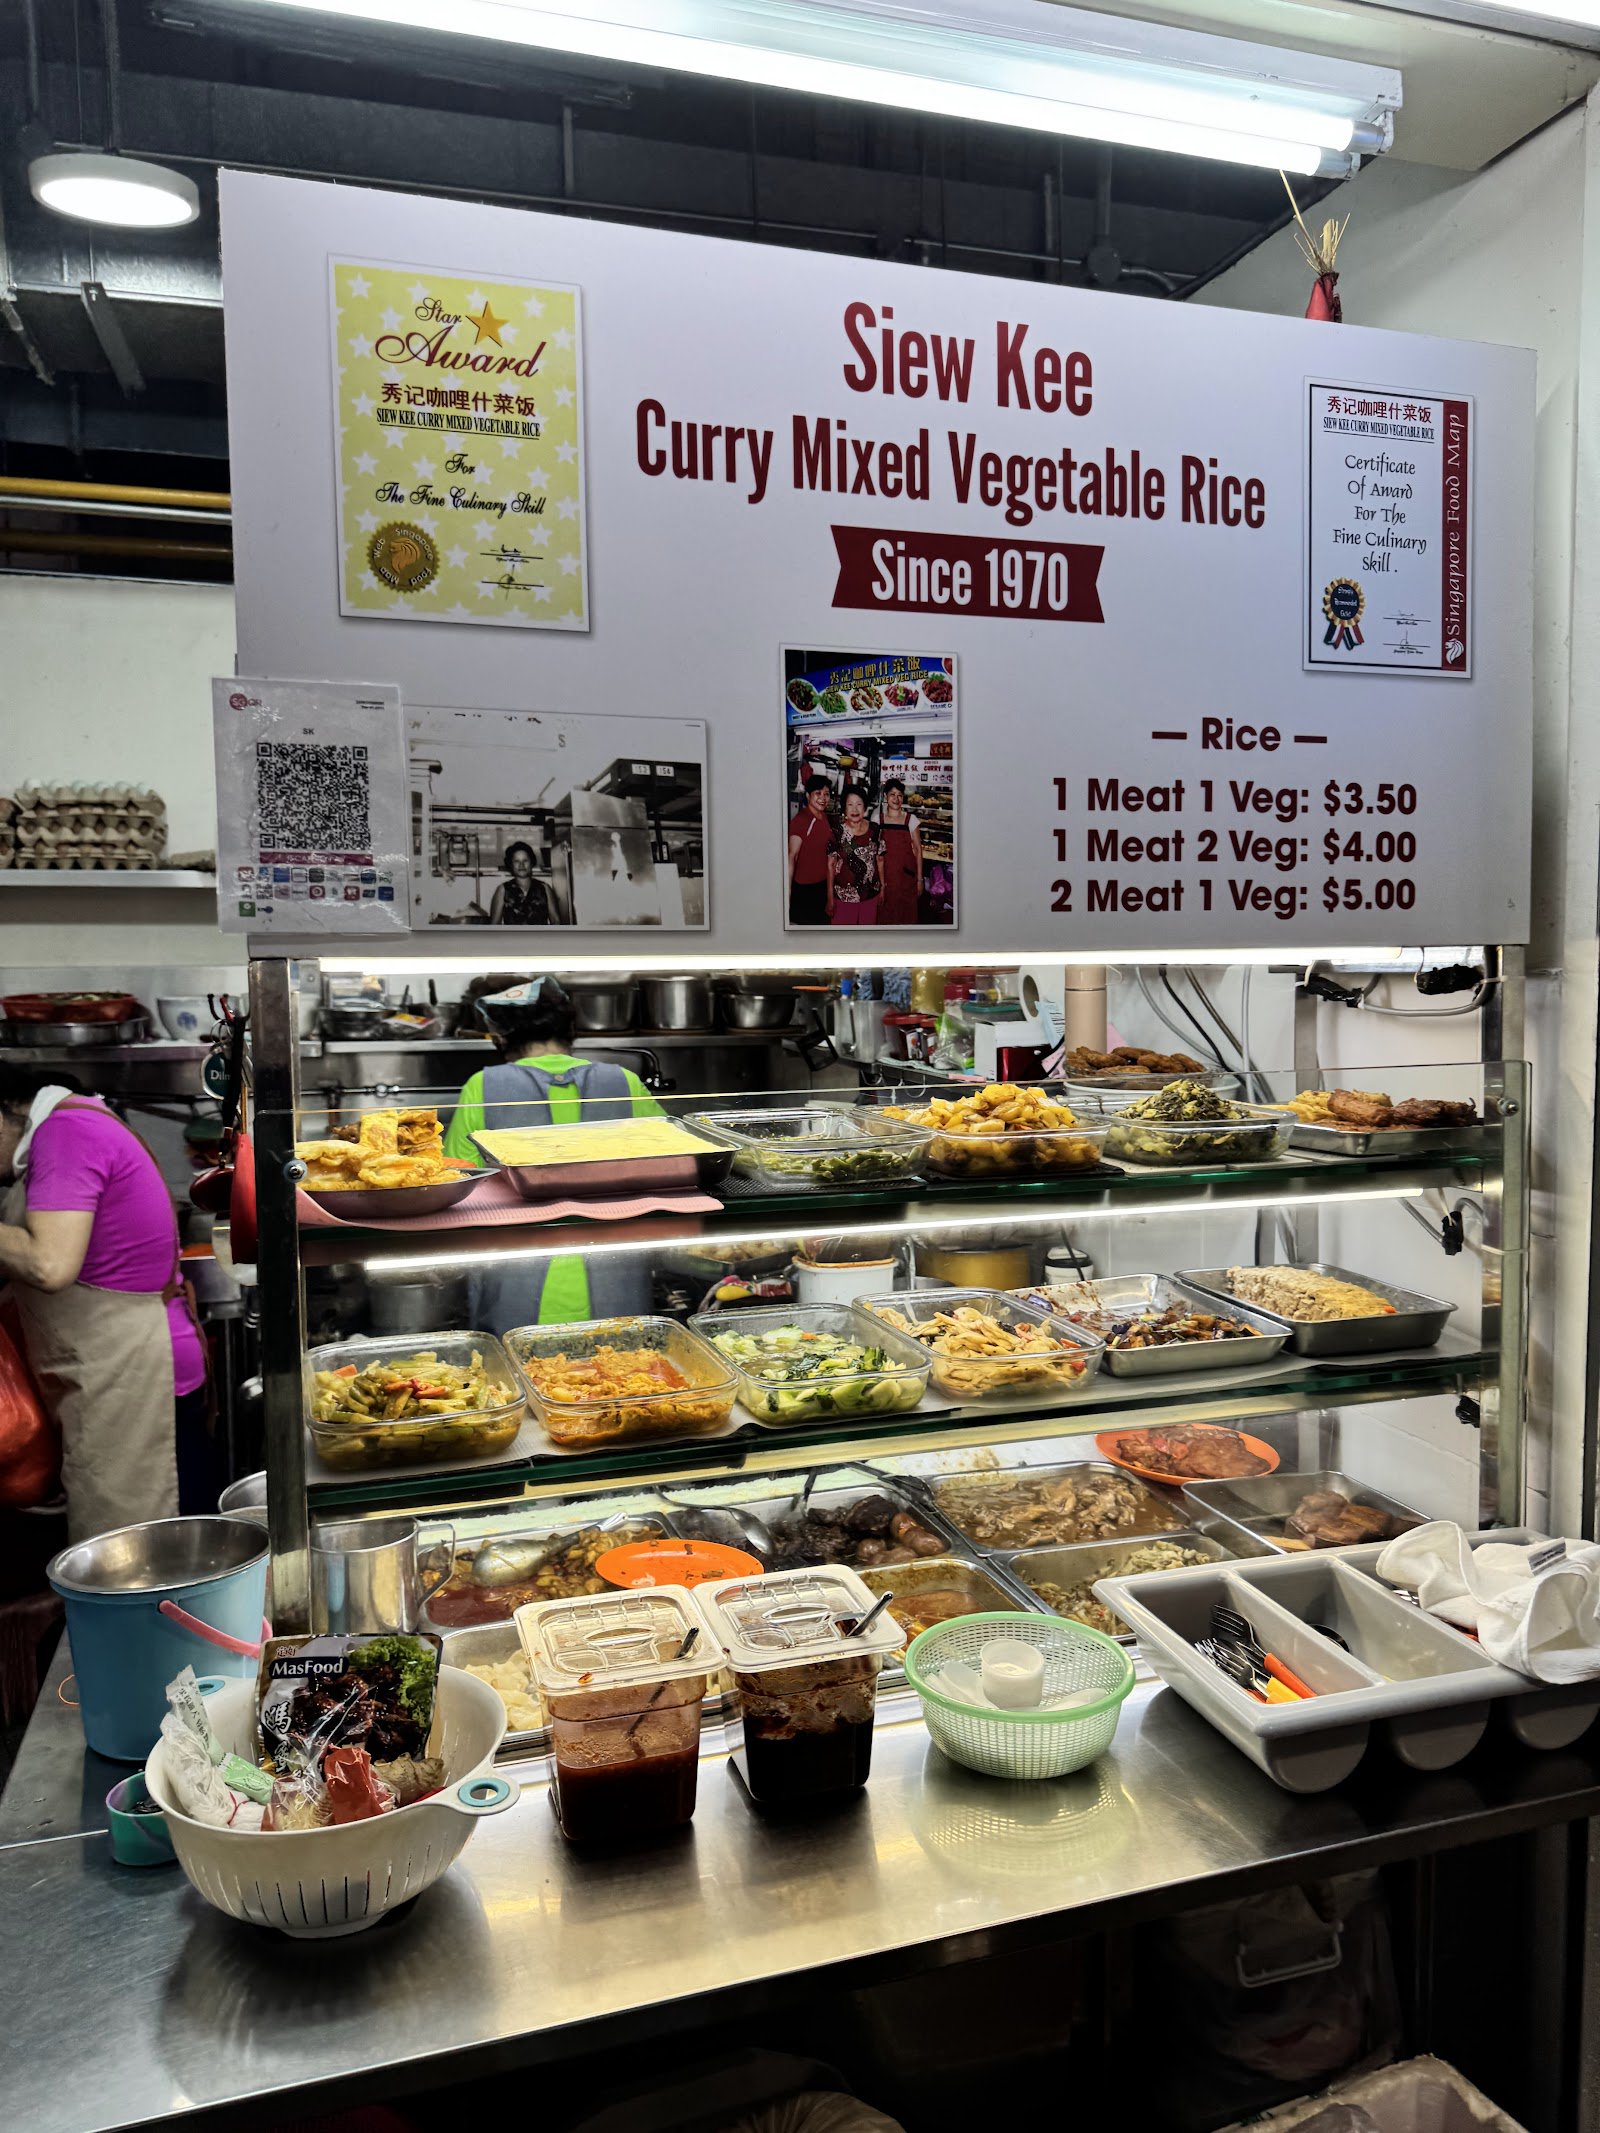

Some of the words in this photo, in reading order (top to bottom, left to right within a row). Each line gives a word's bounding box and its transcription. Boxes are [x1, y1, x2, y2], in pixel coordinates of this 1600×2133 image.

[415, 297, 462, 323] Star
[375, 325, 547, 378] Award
[842, 301, 975, 404] Siew
[996, 320, 1093, 417] Kee
[381, 383, 536, 417] 秀记咖哩什菜饭
[1327, 395, 1432, 424] 秀记咖哩什菜饭
[376, 408, 398, 423] SIEW
[399, 410, 416, 426] KEE
[417, 412, 445, 429] CURRY
[446, 414, 473, 431] MIXED
[474, 417, 521, 436] VEGETABLE
[521, 421, 541, 437] RICE
[1323, 416, 1337, 429] SIEW
[1338, 418, 1350, 431] KEE
[1350, 419, 1369, 433] CURRY
[1370, 421, 1389, 435] MIXED
[1389, 423, 1421, 438] VEGETABLE
[1421, 427, 1435, 440] RICE
[1447, 414, 1465, 468] Map
[445, 453, 476, 474] For
[636, 398, 774, 504] Curry
[792, 414, 930, 501] Mixed
[947, 431, 1165, 527] Vegetable
[1180, 454, 1266, 530] Rice
[1344, 452, 1416, 477] Certificate
[375, 482, 404, 504] The
[409, 484, 446, 506] Fine
[449, 486, 507, 519] Culinary
[511, 492, 547, 515] Skill
[1347, 475, 1366, 500] Of
[1369, 483, 1413, 499] Award
[1445, 475, 1460, 524] Food
[1354, 505, 1377, 521] For
[1380, 502, 1406, 525] The
[1332, 527, 1361, 545] Fine
[1365, 527, 1427, 555] Culinary
[870, 538, 973, 605] Since
[983, 547, 1069, 612] 1970
[1445, 531, 1465, 635] Singapore
[840, 683, 851, 691] KEE
[852, 679, 872, 689] CURRY
[873, 676, 894, 685] MIXED
[895, 673, 909, 683] VEG
[911, 670, 929, 680] RICE
[1201, 717, 1281, 752] Rice
[1053, 777, 1067, 811] 1
[1087, 778, 1185, 812] Meat
[1199, 780, 1213, 812] 1
[1229, 780, 1309, 823] Veg:
[1323, 779, 1417, 817] $3.50
[1053, 829, 1067, 862] 1
[1087, 829, 1185, 863] Meat
[1197, 829, 1218, 862] 2
[1229, 830, 1309, 872] Veg:
[1323, 828, 1416, 865] $4.00
[1050, 879, 1072, 913] 2
[1087, 879, 1185, 913] Meat
[1199, 879, 1212, 911] 1
[1228, 879, 1308, 920] Veg:
[1322, 876, 1416, 914] $5.00
[272, 1658, 344, 1676] MasFood
